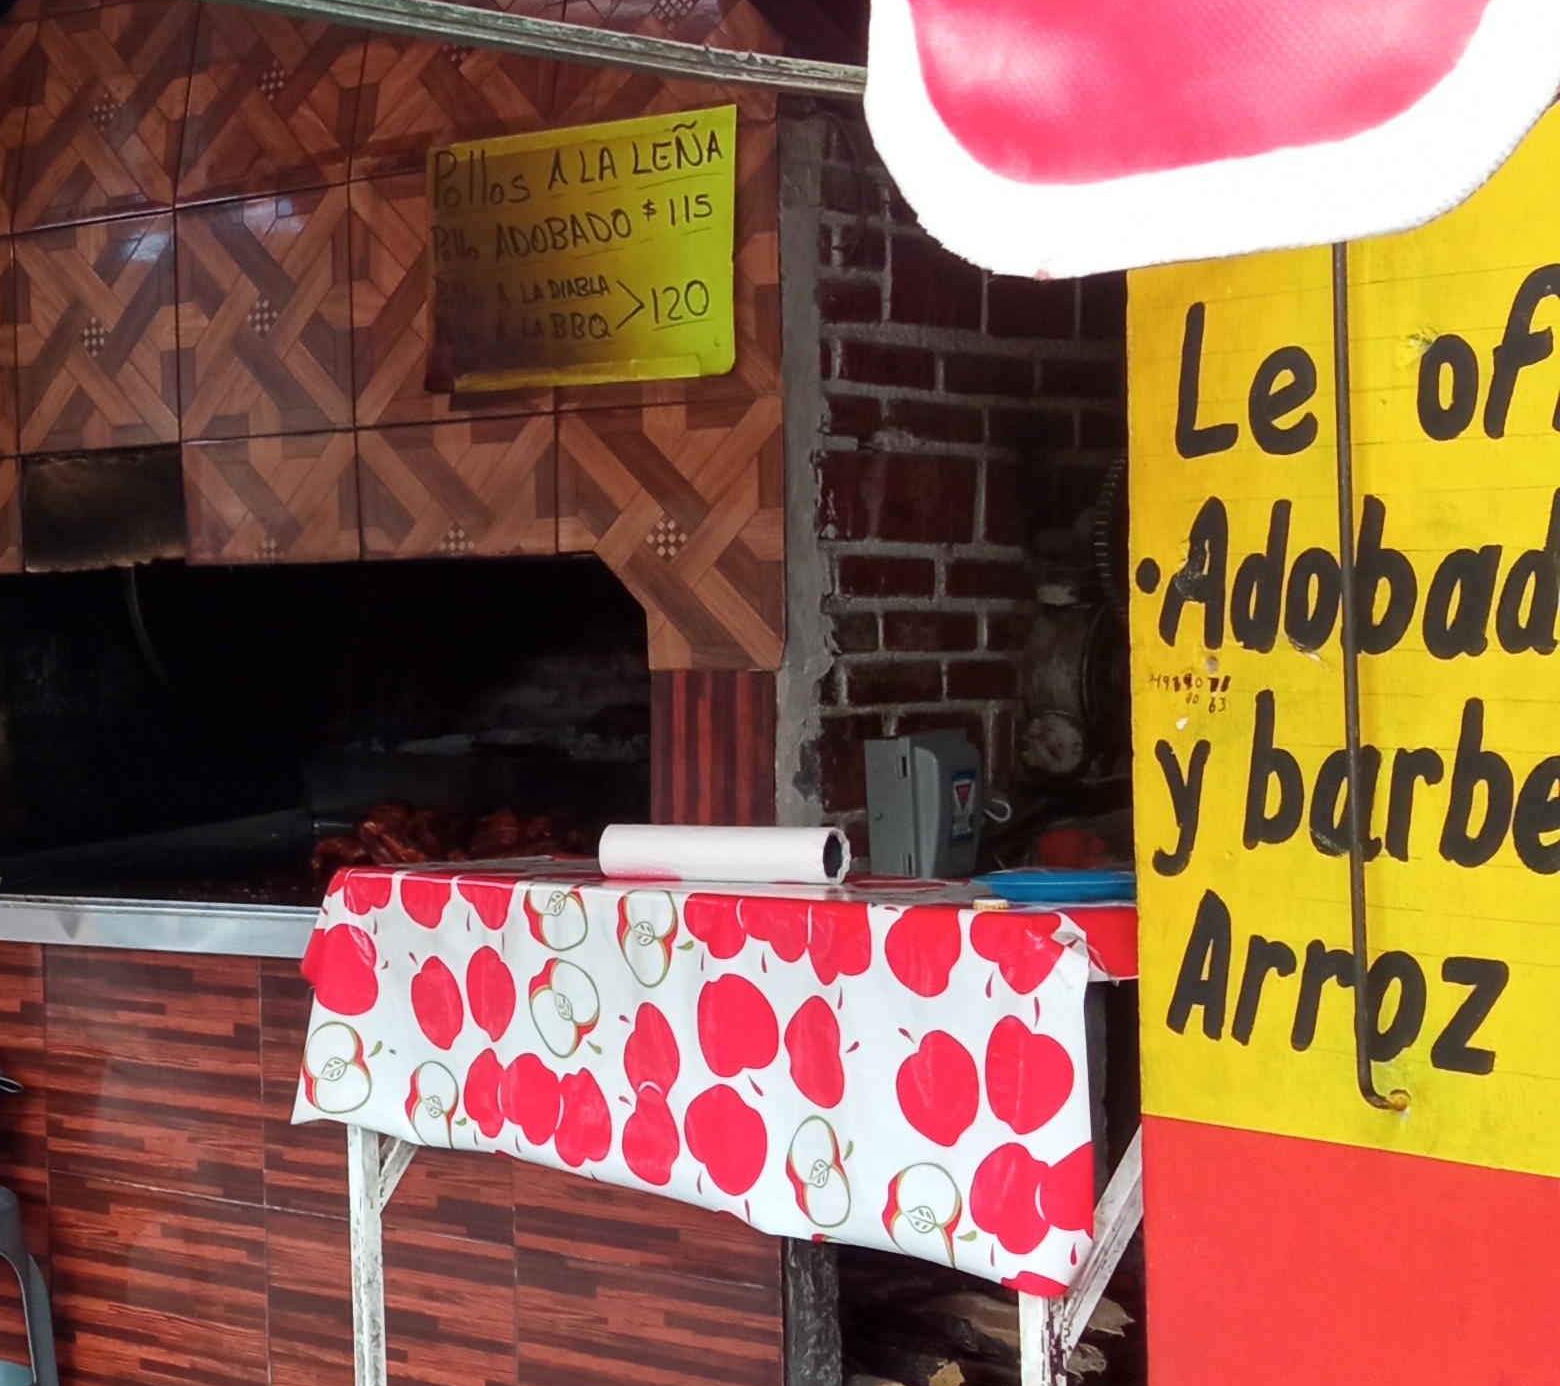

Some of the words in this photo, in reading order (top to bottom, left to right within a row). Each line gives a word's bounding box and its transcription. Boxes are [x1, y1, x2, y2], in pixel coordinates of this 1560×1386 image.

[432, 149, 530, 209] Pollos
[547, 150, 569, 190] A
[580, 146, 617, 185] LA
[632, 120, 724, 175] LEÑA
[494, 208, 633, 261] ADOBADO
[550, 274, 612, 301] DIABLA
[650, 279, 711, 326] 120
[548, 312, 613, 340] BBQ
[1174, 301, 1318, 459] Le
[1417, 263, 1560, 442] of
[1152, 738, 1211, 878] y
[1167, 889, 1509, 1076] Arroz
